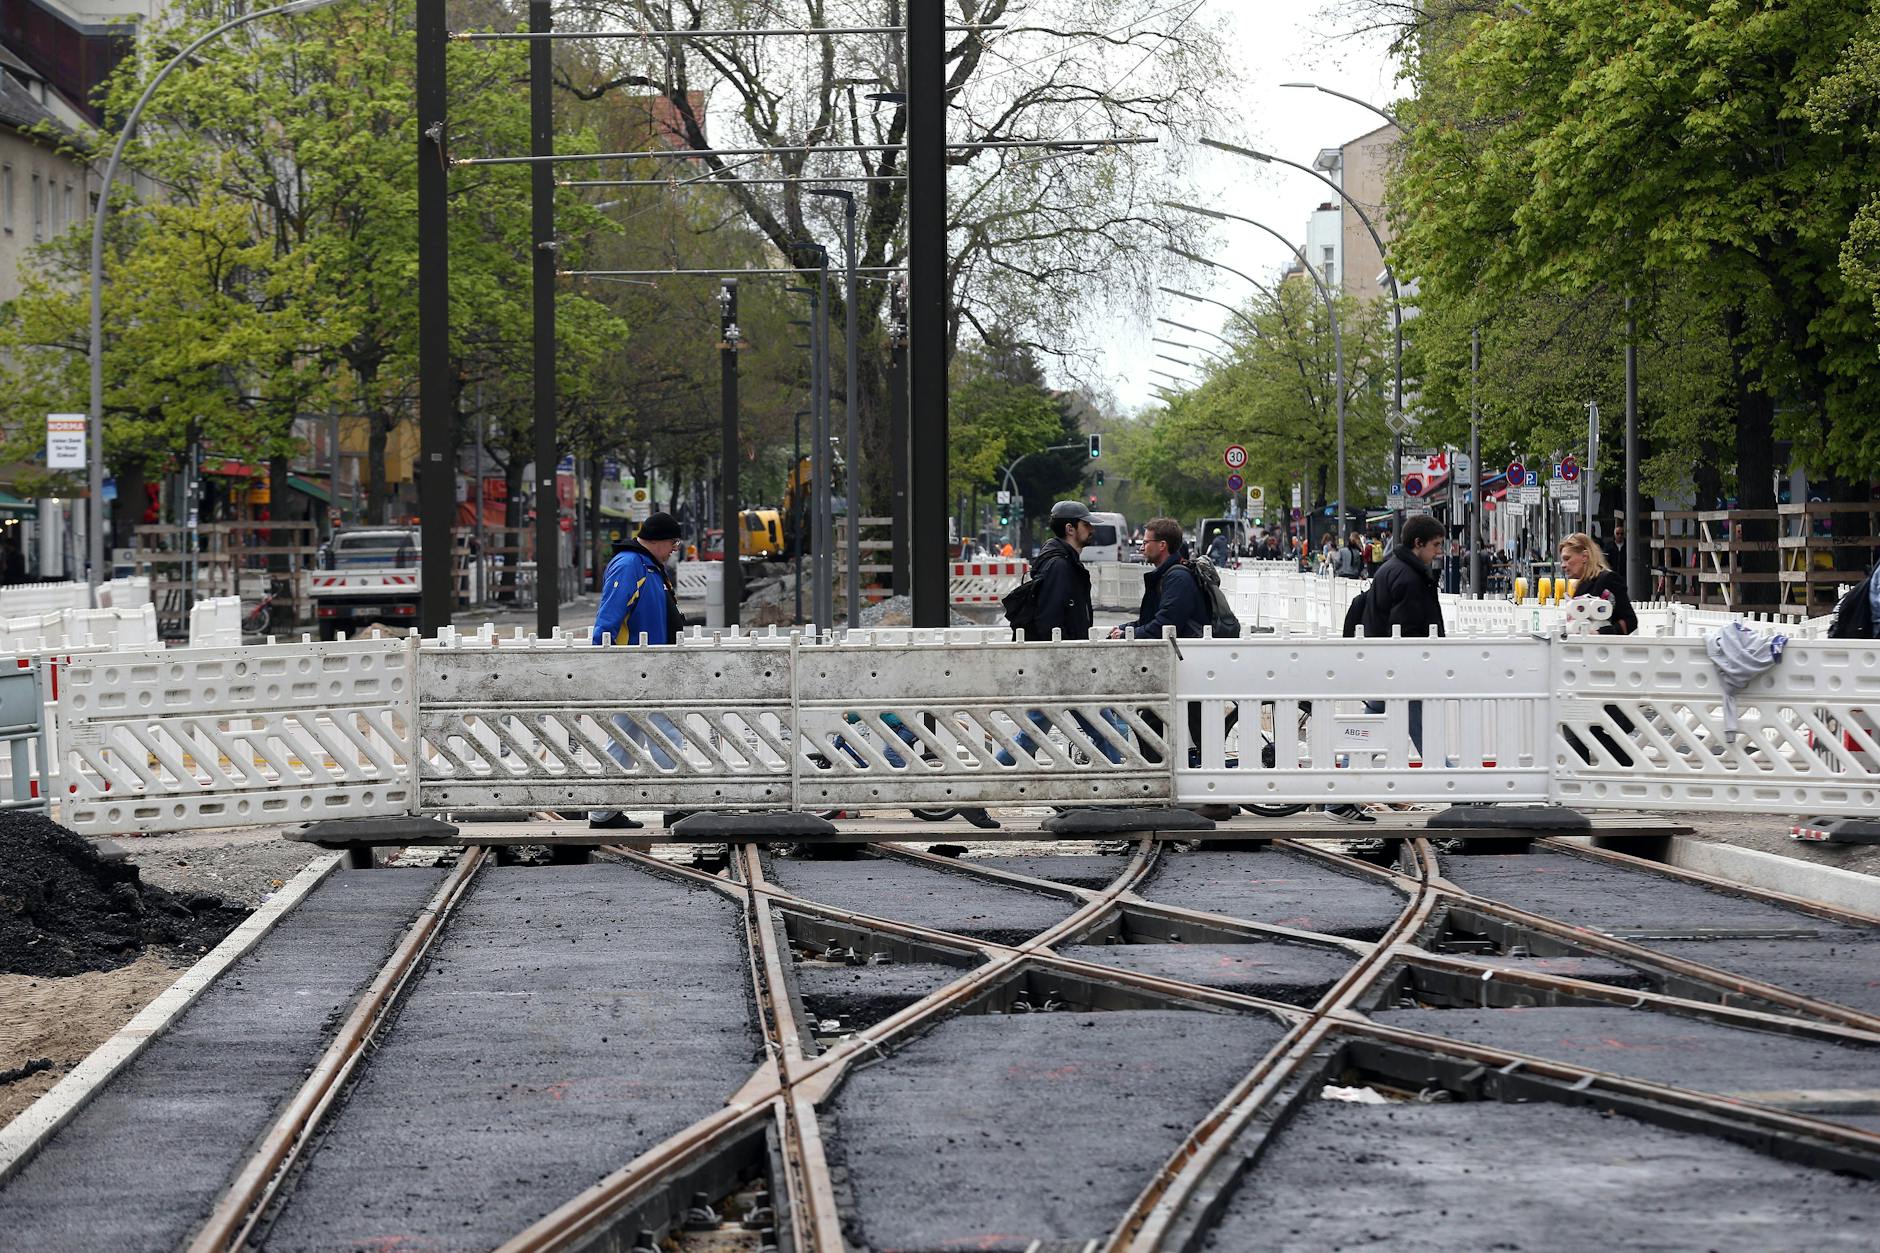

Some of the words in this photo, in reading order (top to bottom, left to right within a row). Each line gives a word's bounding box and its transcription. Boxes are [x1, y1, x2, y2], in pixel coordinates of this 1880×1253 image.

[1229, 452, 1243, 462] 30
[1525, 474, 1533, 486] P
[1391, 485, 1398, 495] P
